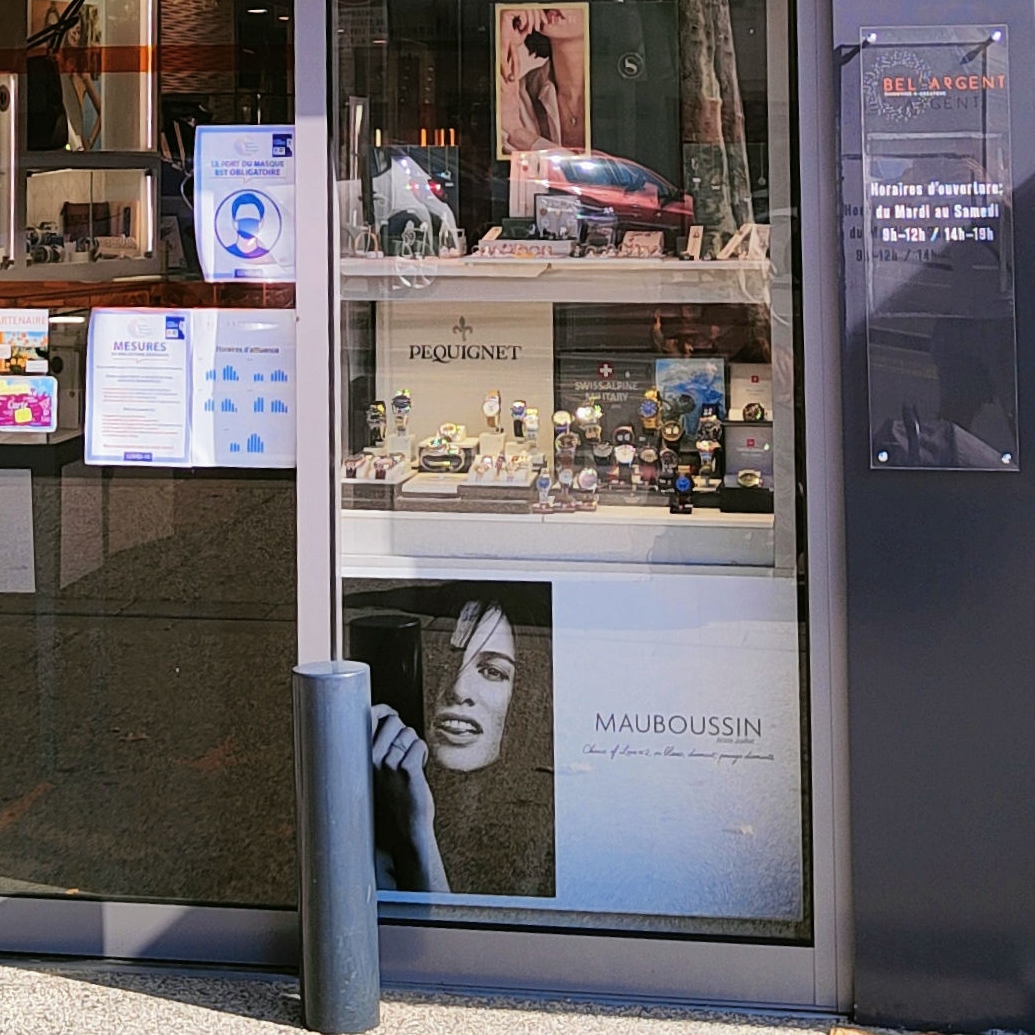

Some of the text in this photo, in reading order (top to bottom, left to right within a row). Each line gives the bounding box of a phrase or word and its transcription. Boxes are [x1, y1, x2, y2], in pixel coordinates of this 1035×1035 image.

[928, 74, 1006, 91] ARGENT
[221, 160, 240, 168] PORT
[241, 160, 253, 168] DU
[253, 160, 285, 168] MASQUE
[215, 168, 281, 176] EST OBLIGATOIRE
[870, 181, 923, 197] Horaires
[876, 203, 1000, 219] du Mardi au Samedi
[882, 227, 926, 242] 9h-12h
[944, 227, 994, 242] 14h-19h
[113, 341, 168, 352] MESURES
[408, 344, 523, 363] PEQUIGNET
[574, 381, 639, 391] SWISS ALPINE
[595, 712, 762, 737] MAUBOUSSIN
